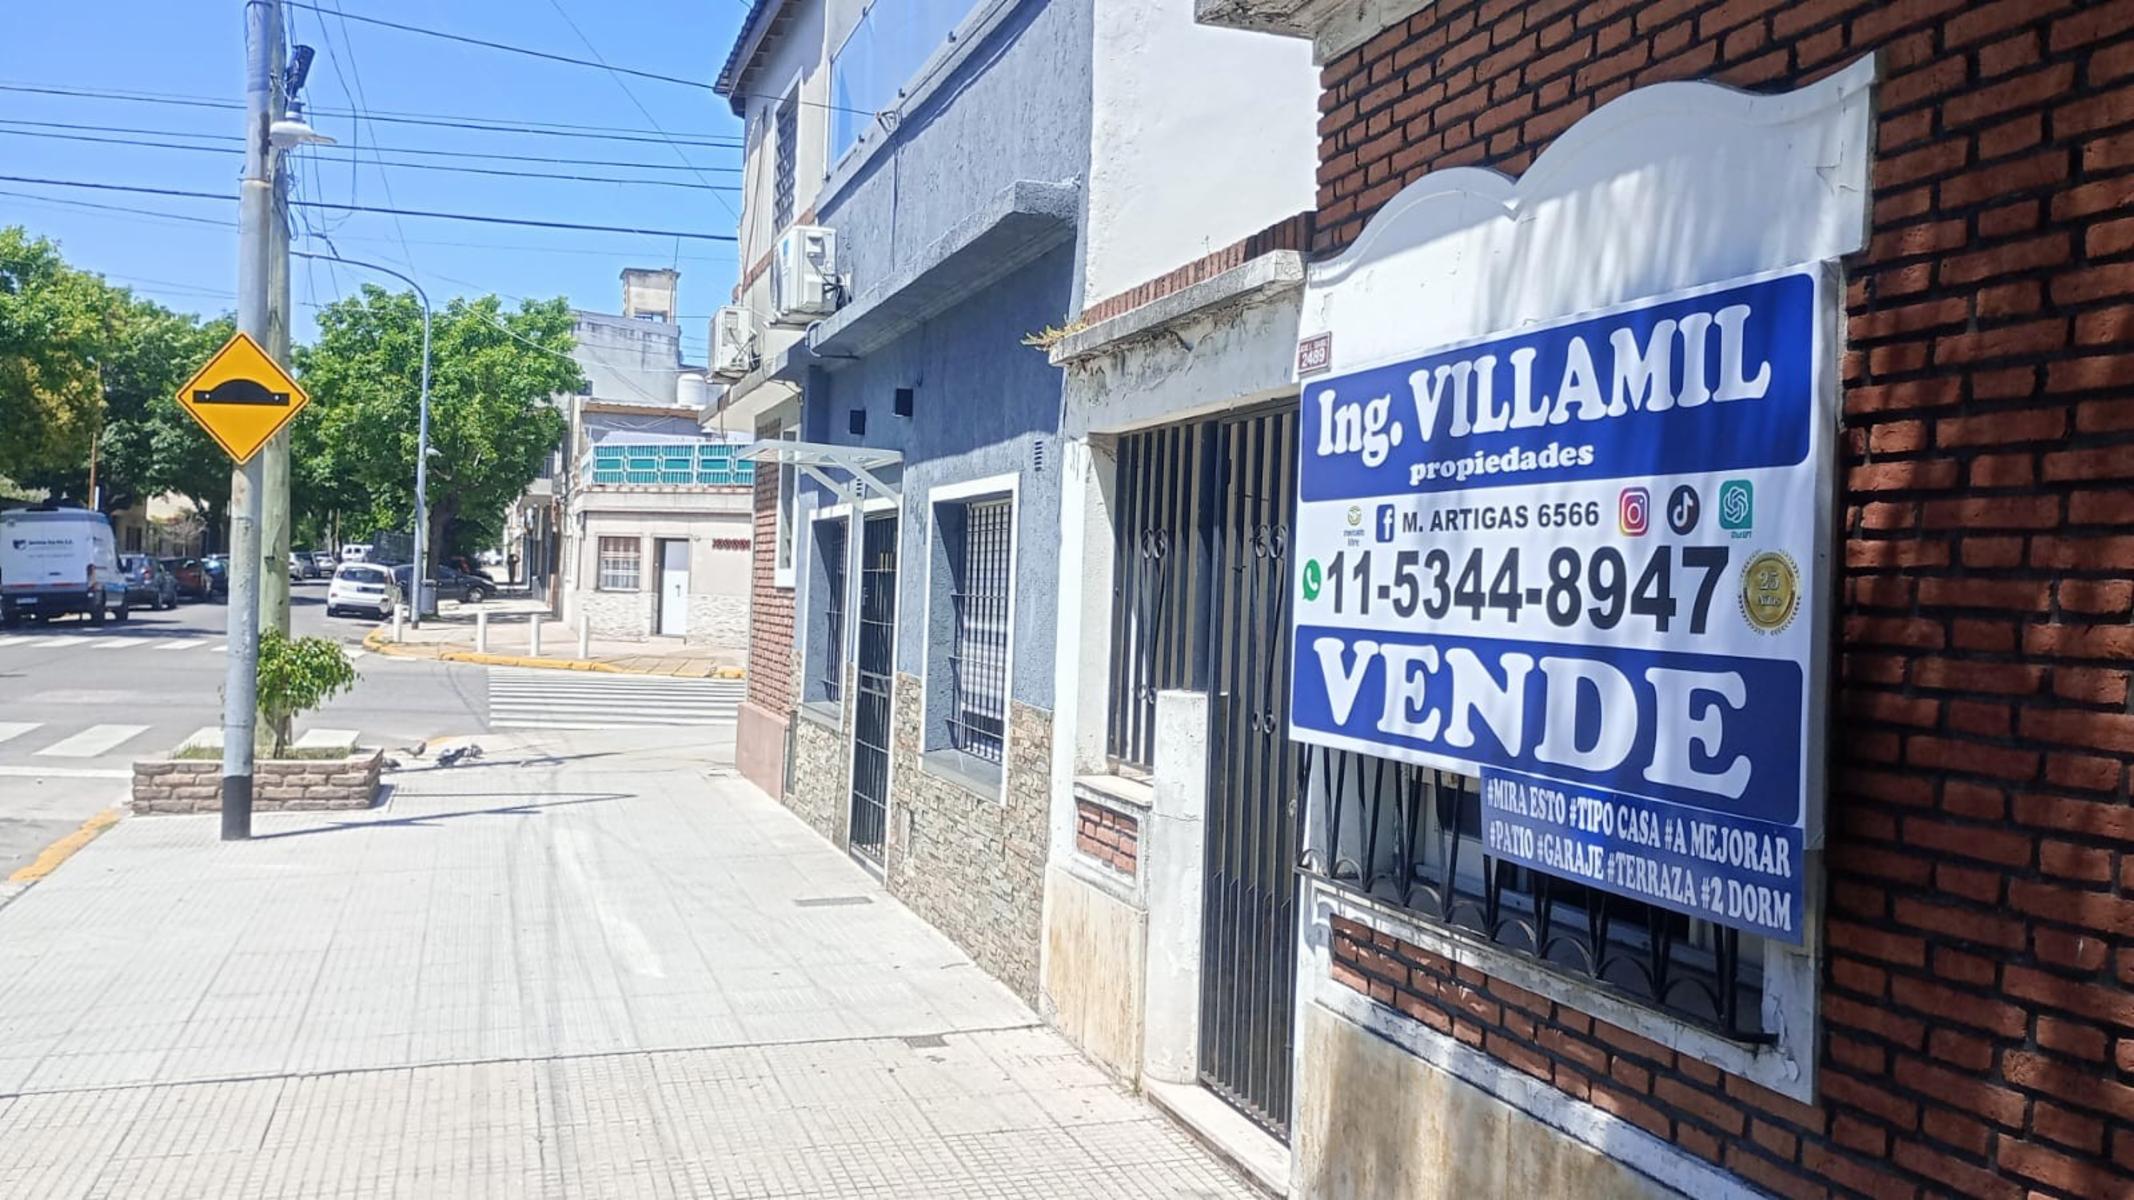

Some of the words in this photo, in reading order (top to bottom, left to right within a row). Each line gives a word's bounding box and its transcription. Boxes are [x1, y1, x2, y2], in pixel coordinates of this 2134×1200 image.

[1301, 347, 1326, 367] 2489
[1317, 389, 1402, 467] Ing.
[1408, 304, 1772, 442] VILLAMIL
[1409, 442, 1595, 486] propiedades
[1402, 513, 1424, 532] M.
[1429, 506, 1529, 531] ARTIGAS
[1538, 501, 1600, 527] 6566
[1326, 545, 1730, 635] 11-5344-8947
[1759, 570, 1780, 590] 25
[1312, 636, 1753, 799] VENDE
[1487, 778, 1528, 815] #MIRA
[1530, 784, 1566, 825] ESTO
[1569, 796, 1614, 836] #TIPO
[1617, 804, 1661, 848] CASA
[1664, 817, 1688, 854] #A
[1690, 820, 1791, 878] MEJORAR
[1489, 820, 1534, 860] #PATIO
[1537, 832, 1604, 880] #GARAJE
[1607, 851, 1697, 907] #TERRAZA
[1701, 875, 1724, 916] #2
[1727, 879, 1792, 932] DORM
